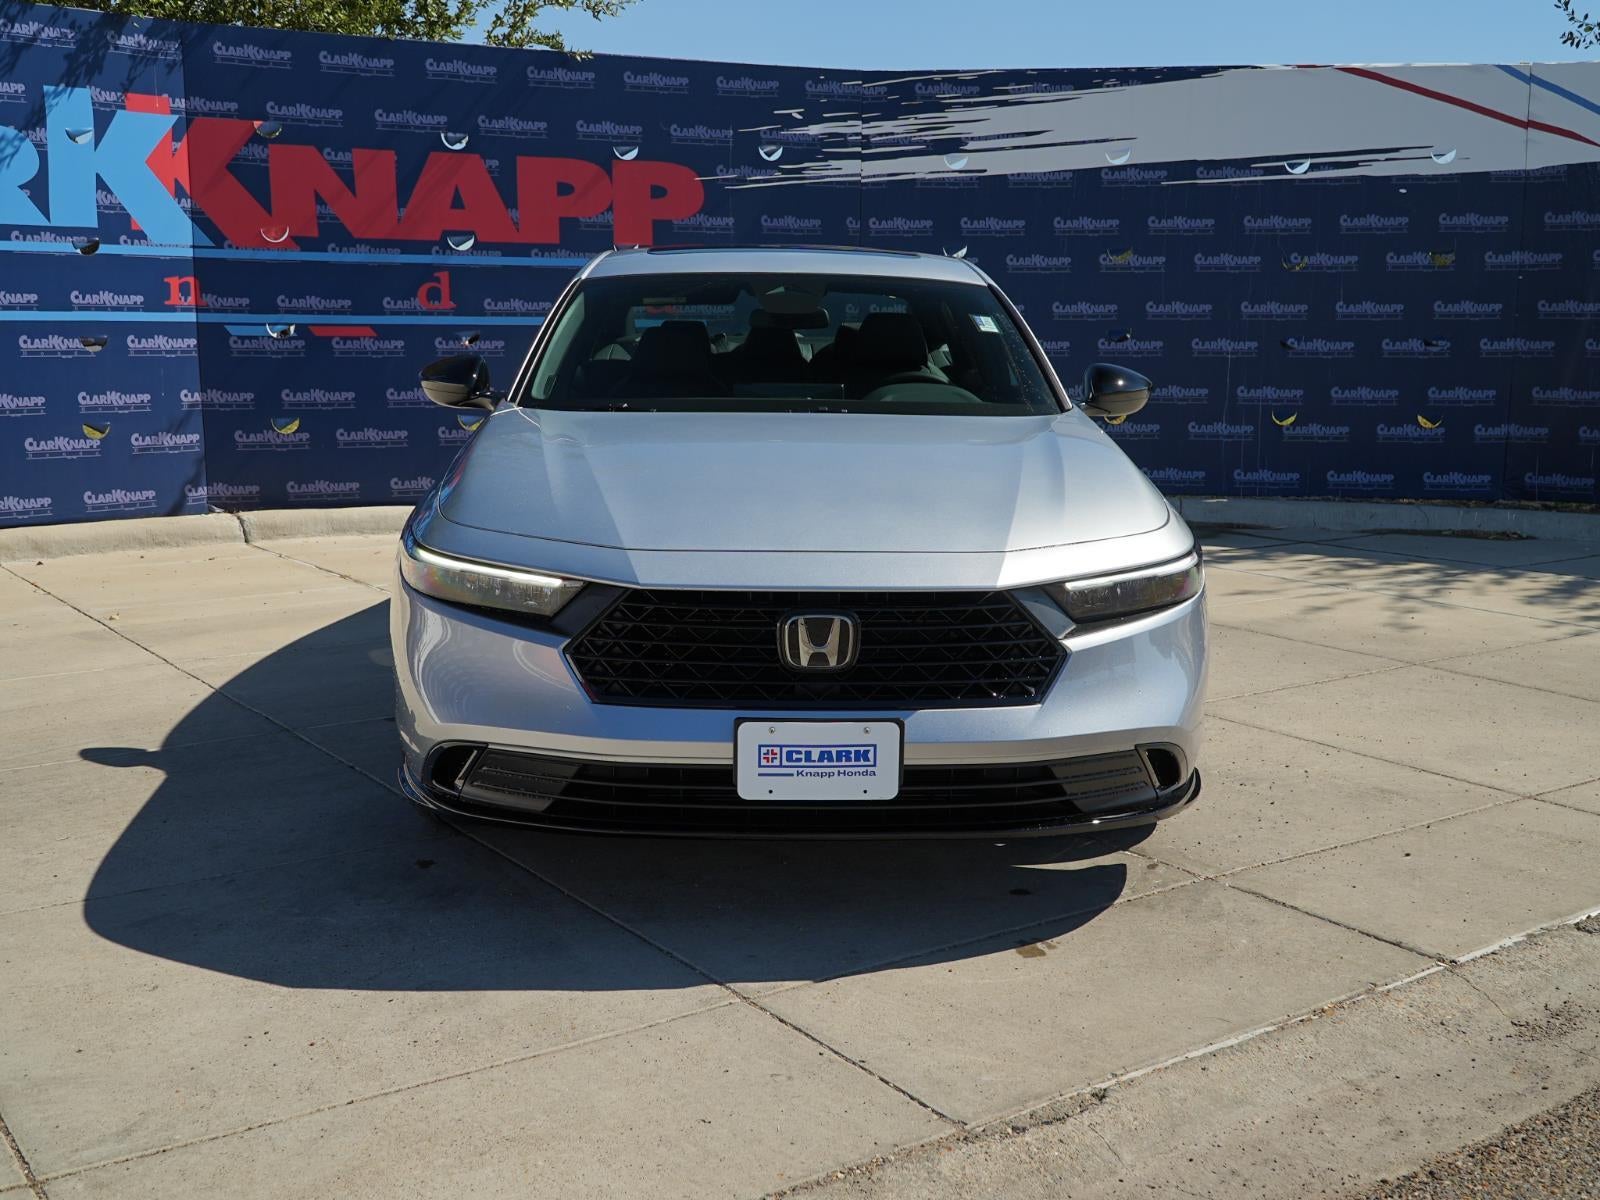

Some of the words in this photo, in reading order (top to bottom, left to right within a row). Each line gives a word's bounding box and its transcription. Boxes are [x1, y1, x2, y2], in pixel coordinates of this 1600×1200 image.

[785, 749, 871, 763] CLARK
[796, 769, 835, 779] Knapp
[837, 769, 877, 777] Honda
